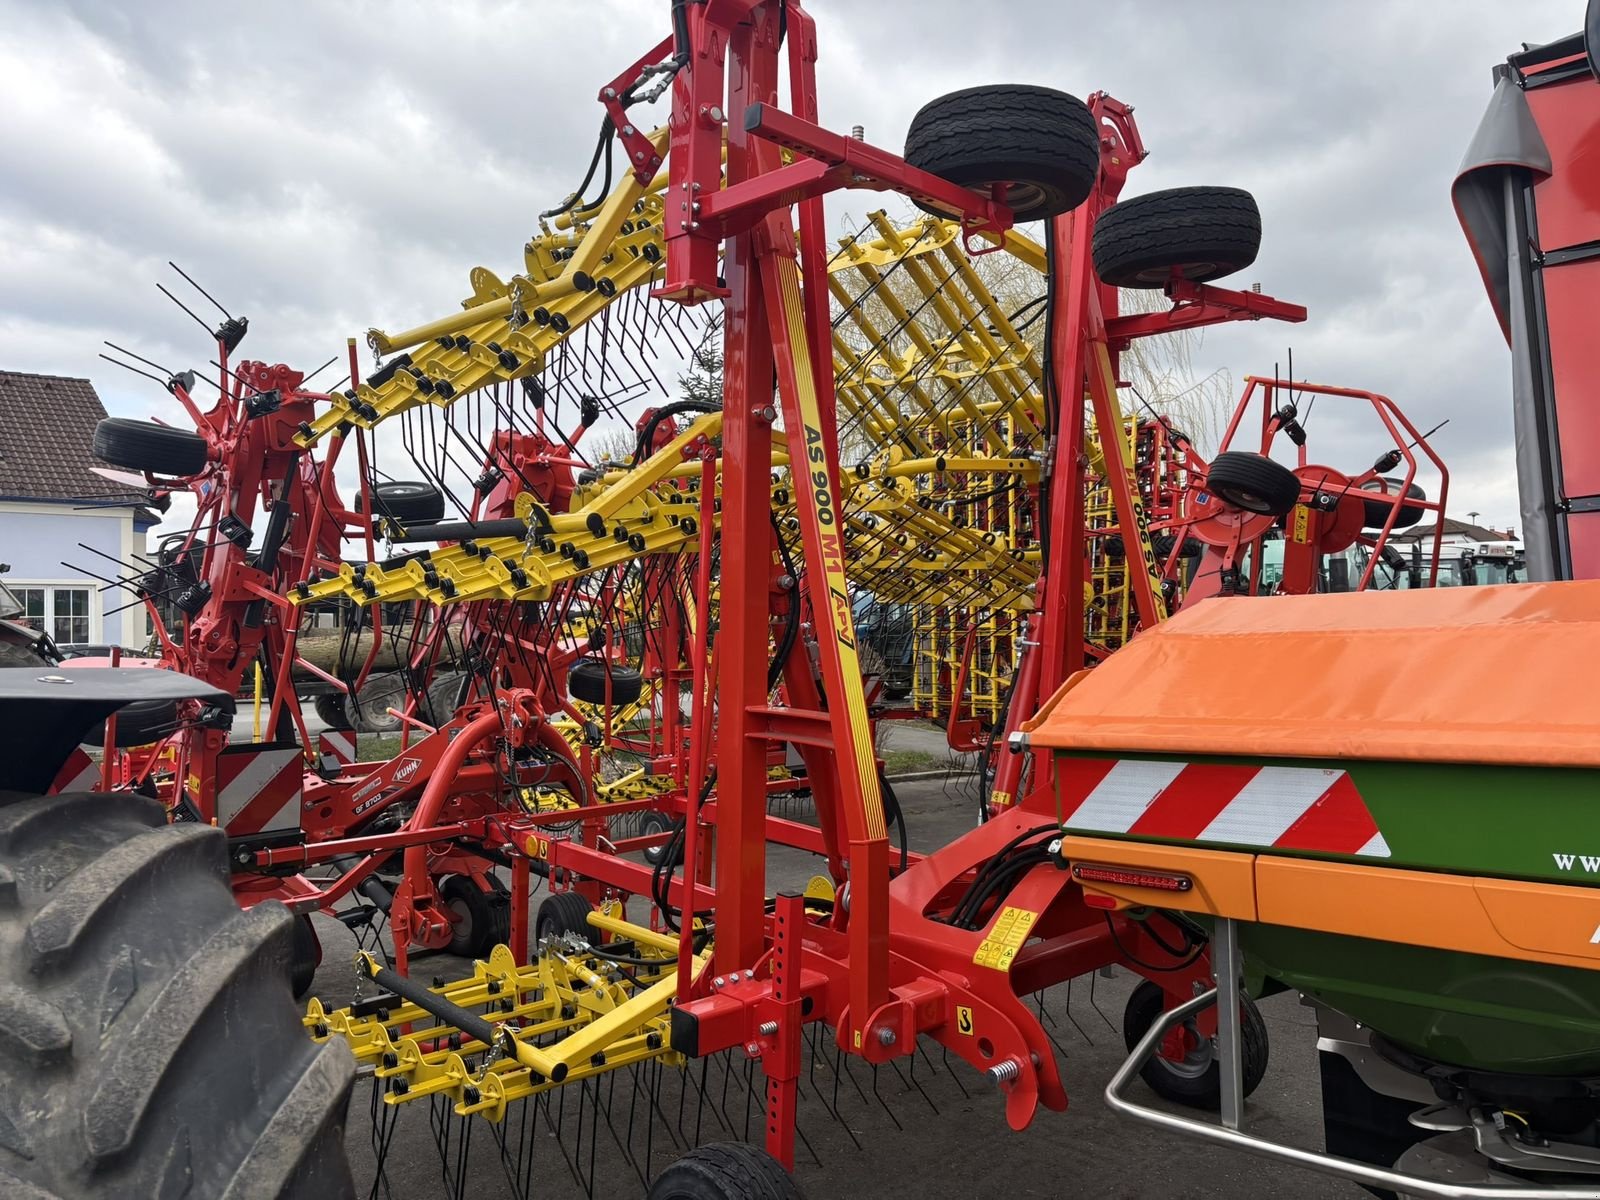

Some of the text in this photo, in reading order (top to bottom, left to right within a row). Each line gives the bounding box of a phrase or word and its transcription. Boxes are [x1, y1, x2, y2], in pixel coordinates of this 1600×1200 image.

[804, 424, 824, 464] AS
[812, 471, 834, 526] 900
[1134, 502, 1150, 545] 900
[821, 533, 842, 573] M1
[1144, 549, 1159, 579] AS
[396, 761, 418, 781] KUHN
[365, 793, 382, 808] 8703
